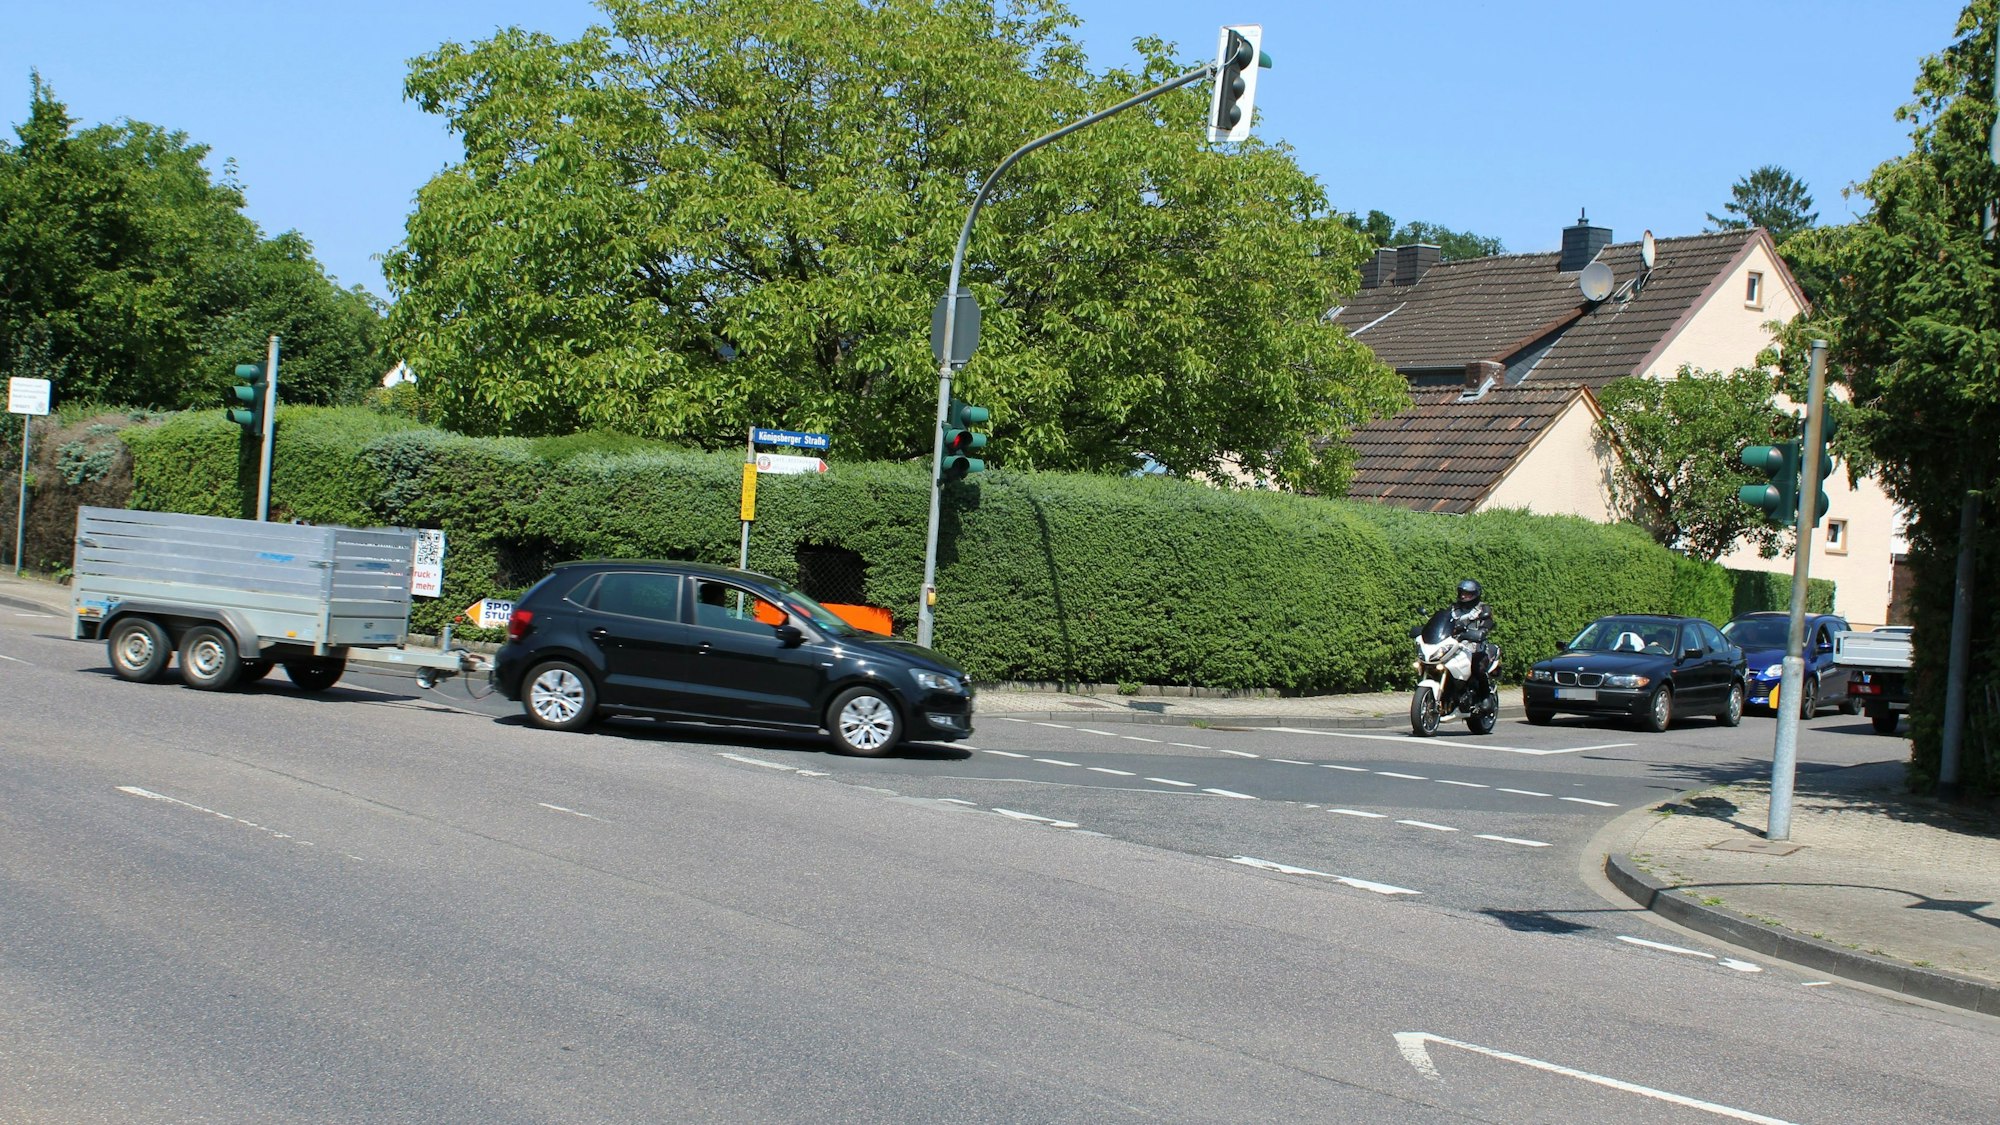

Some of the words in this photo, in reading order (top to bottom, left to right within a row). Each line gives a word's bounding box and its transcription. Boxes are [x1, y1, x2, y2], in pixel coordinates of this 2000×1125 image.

[758, 431, 802, 445] Königsberger
[804, 435, 826, 446] Straße
[413, 570, 431, 579] ruck
[415, 583, 436, 591] mehr
[486, 602, 512, 611] SPO
